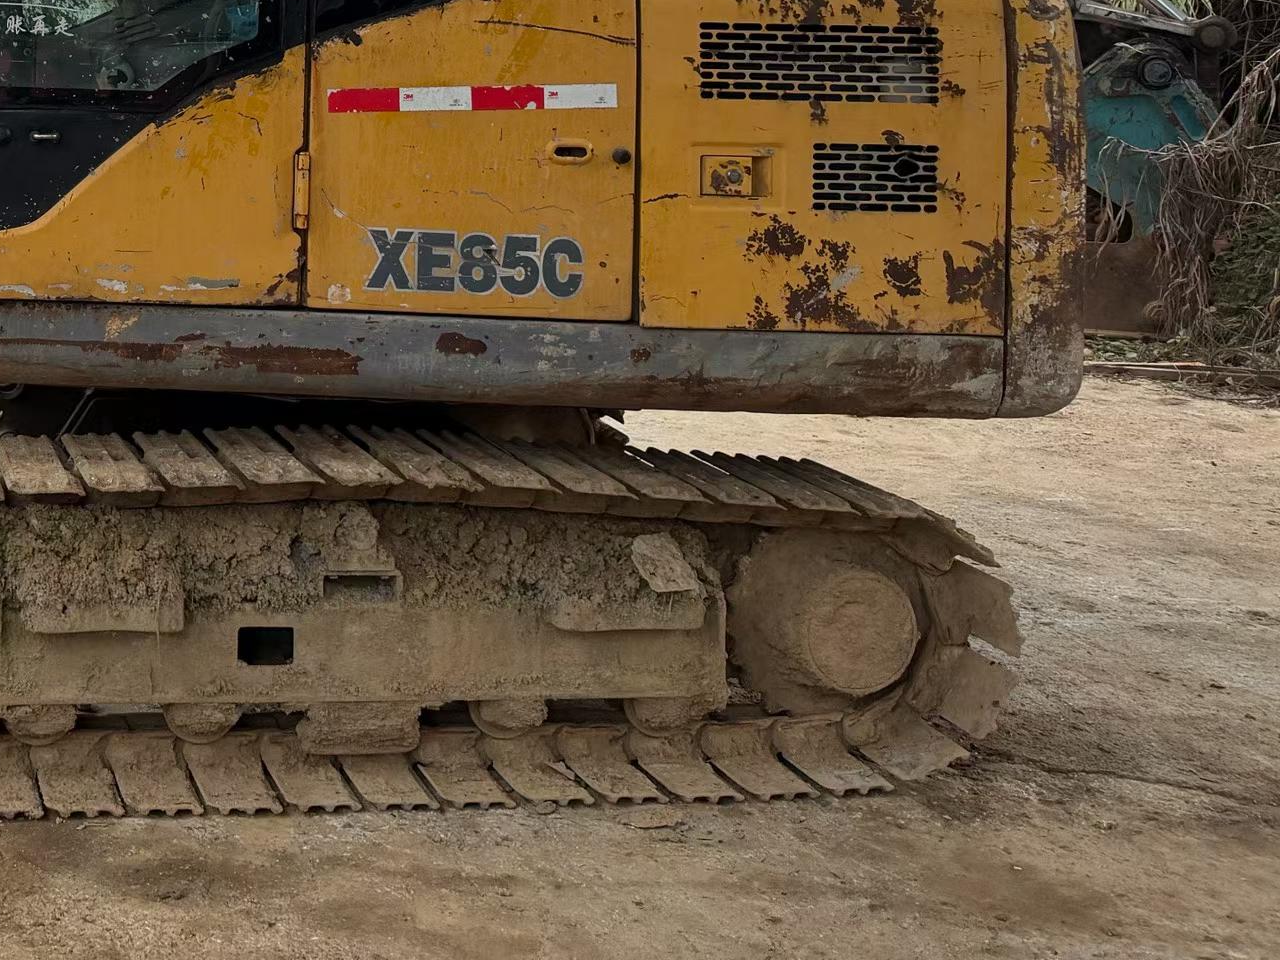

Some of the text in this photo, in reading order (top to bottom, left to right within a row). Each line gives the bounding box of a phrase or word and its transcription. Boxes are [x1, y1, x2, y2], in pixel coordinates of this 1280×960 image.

[403, 93, 414, 101] 3M
[547, 91, 559, 99] 3M
[363, 227, 585, 300] XE85C
